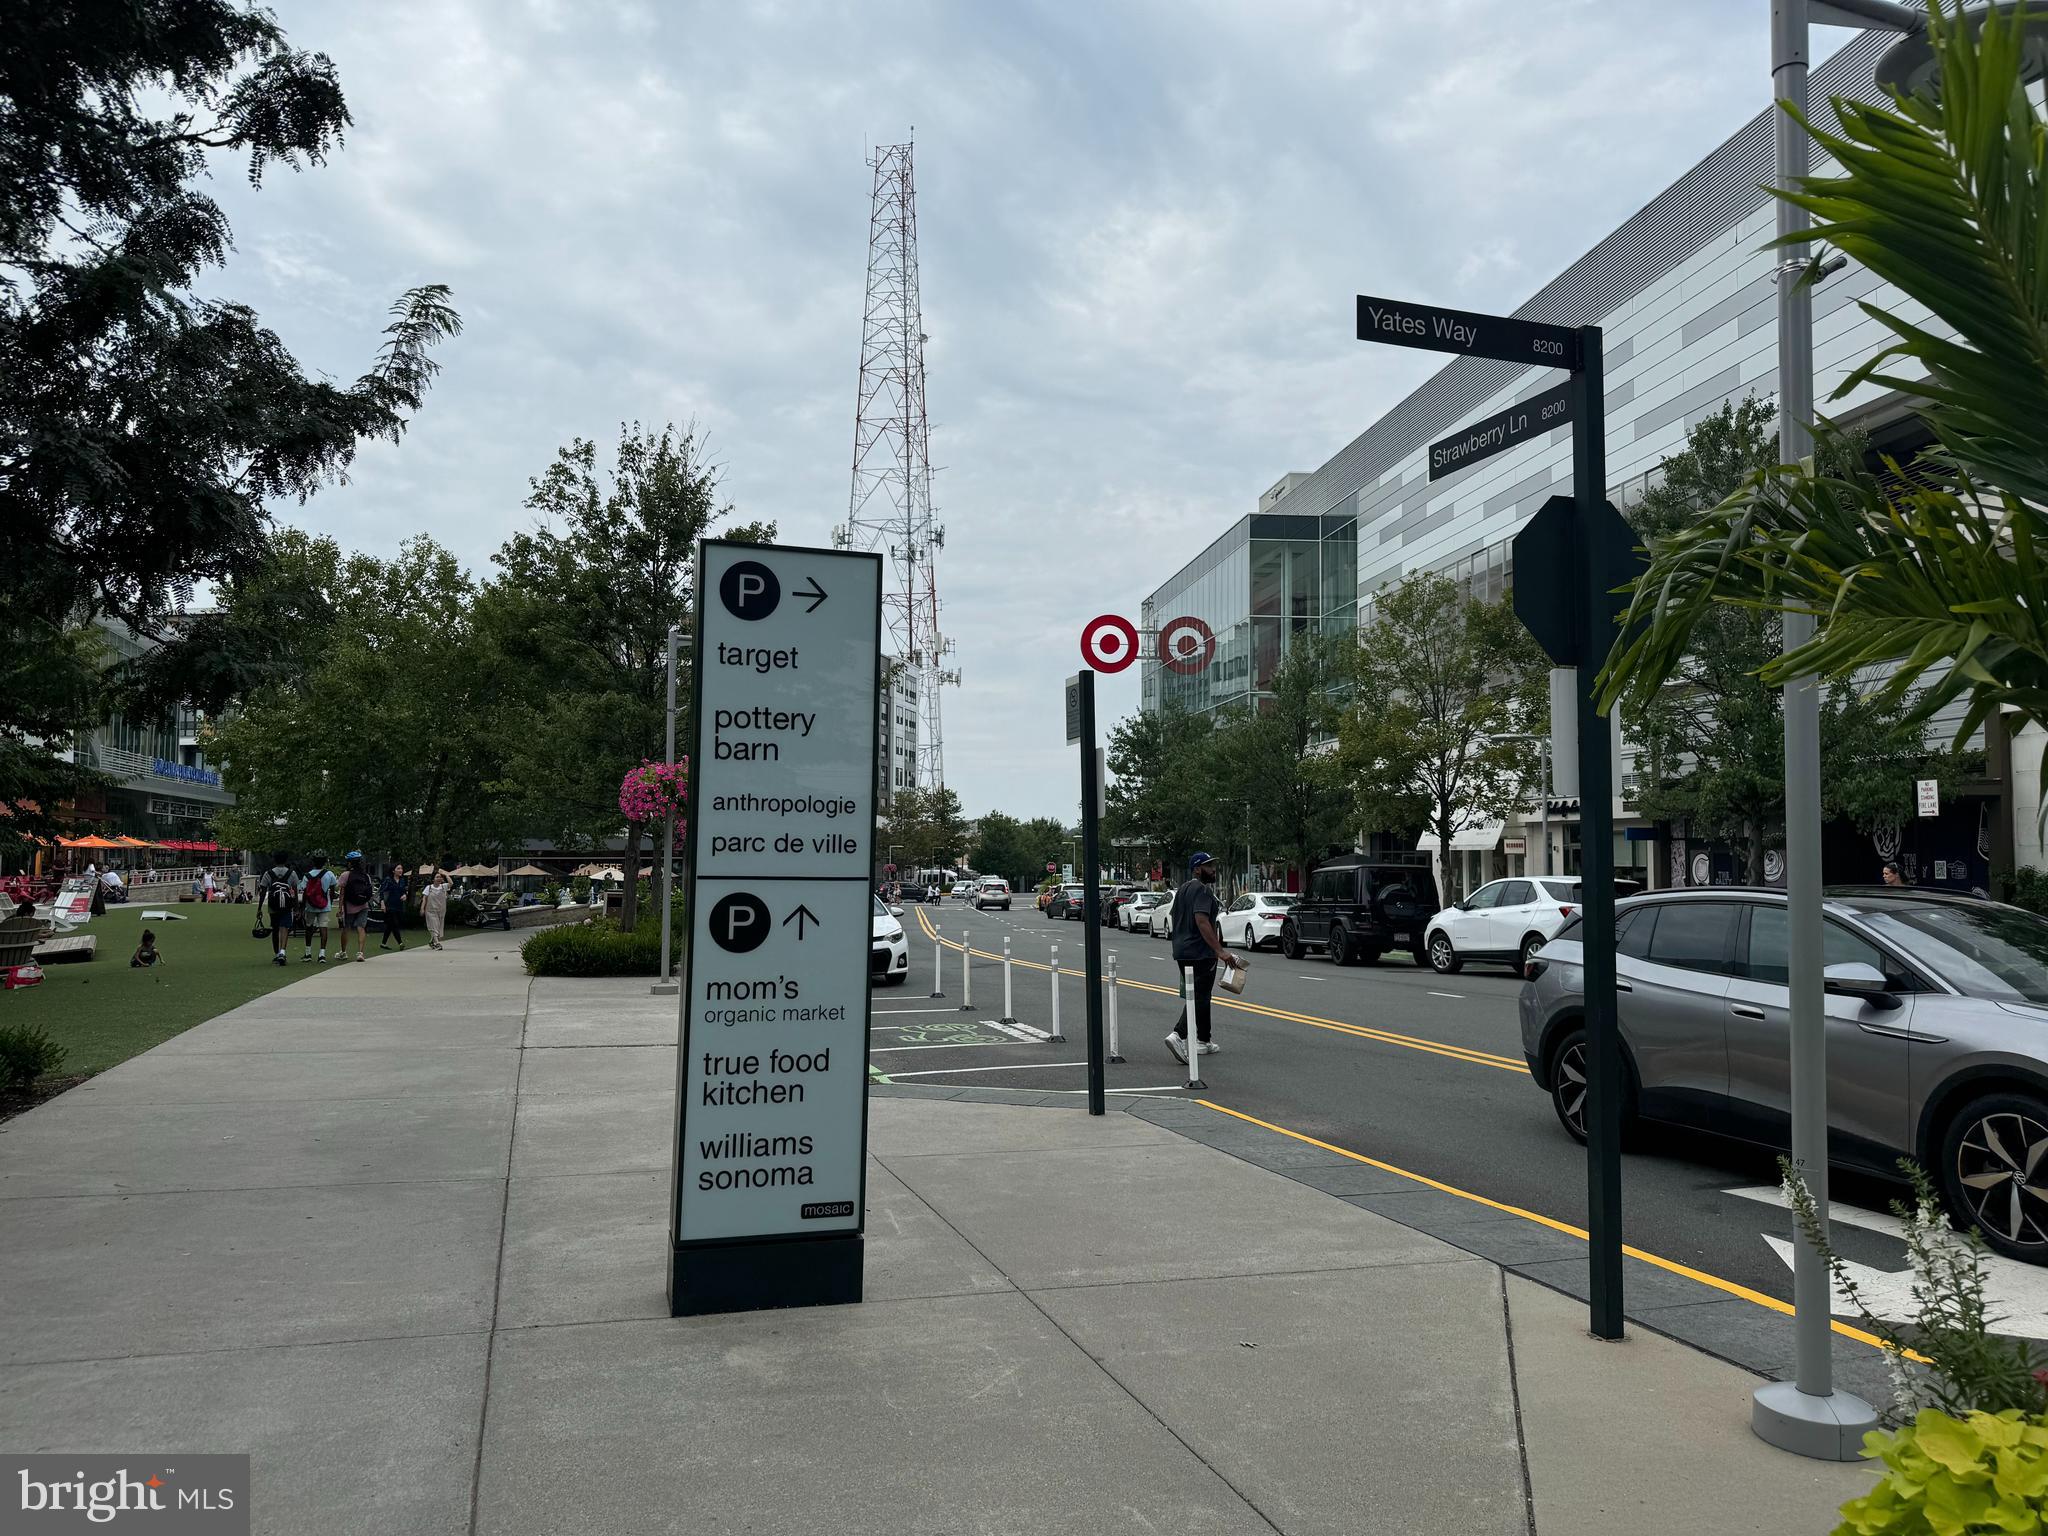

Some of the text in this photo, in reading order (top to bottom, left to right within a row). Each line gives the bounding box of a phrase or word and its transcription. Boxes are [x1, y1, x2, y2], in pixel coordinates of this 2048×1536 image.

[1368, 306, 1562, 355] Yates Way 8200
[1433, 400, 1565, 469] Strawberry Ln 8200
[718, 643, 798, 673] target
[715, 707, 816, 737] pottery
[715, 736, 779, 761] barn
[713, 793, 855, 818] anthropologie
[712, 833, 856, 856] parc de ville
[707, 976, 798, 1000] mom's
[705, 1005, 844, 1026] organic market
[704, 1048, 829, 1075] true food
[703, 1080, 803, 1106] kitchen
[700, 1133, 813, 1159] williams
[699, 1166, 813, 1190] sonoma
[805, 1203, 851, 1217] mosaic
